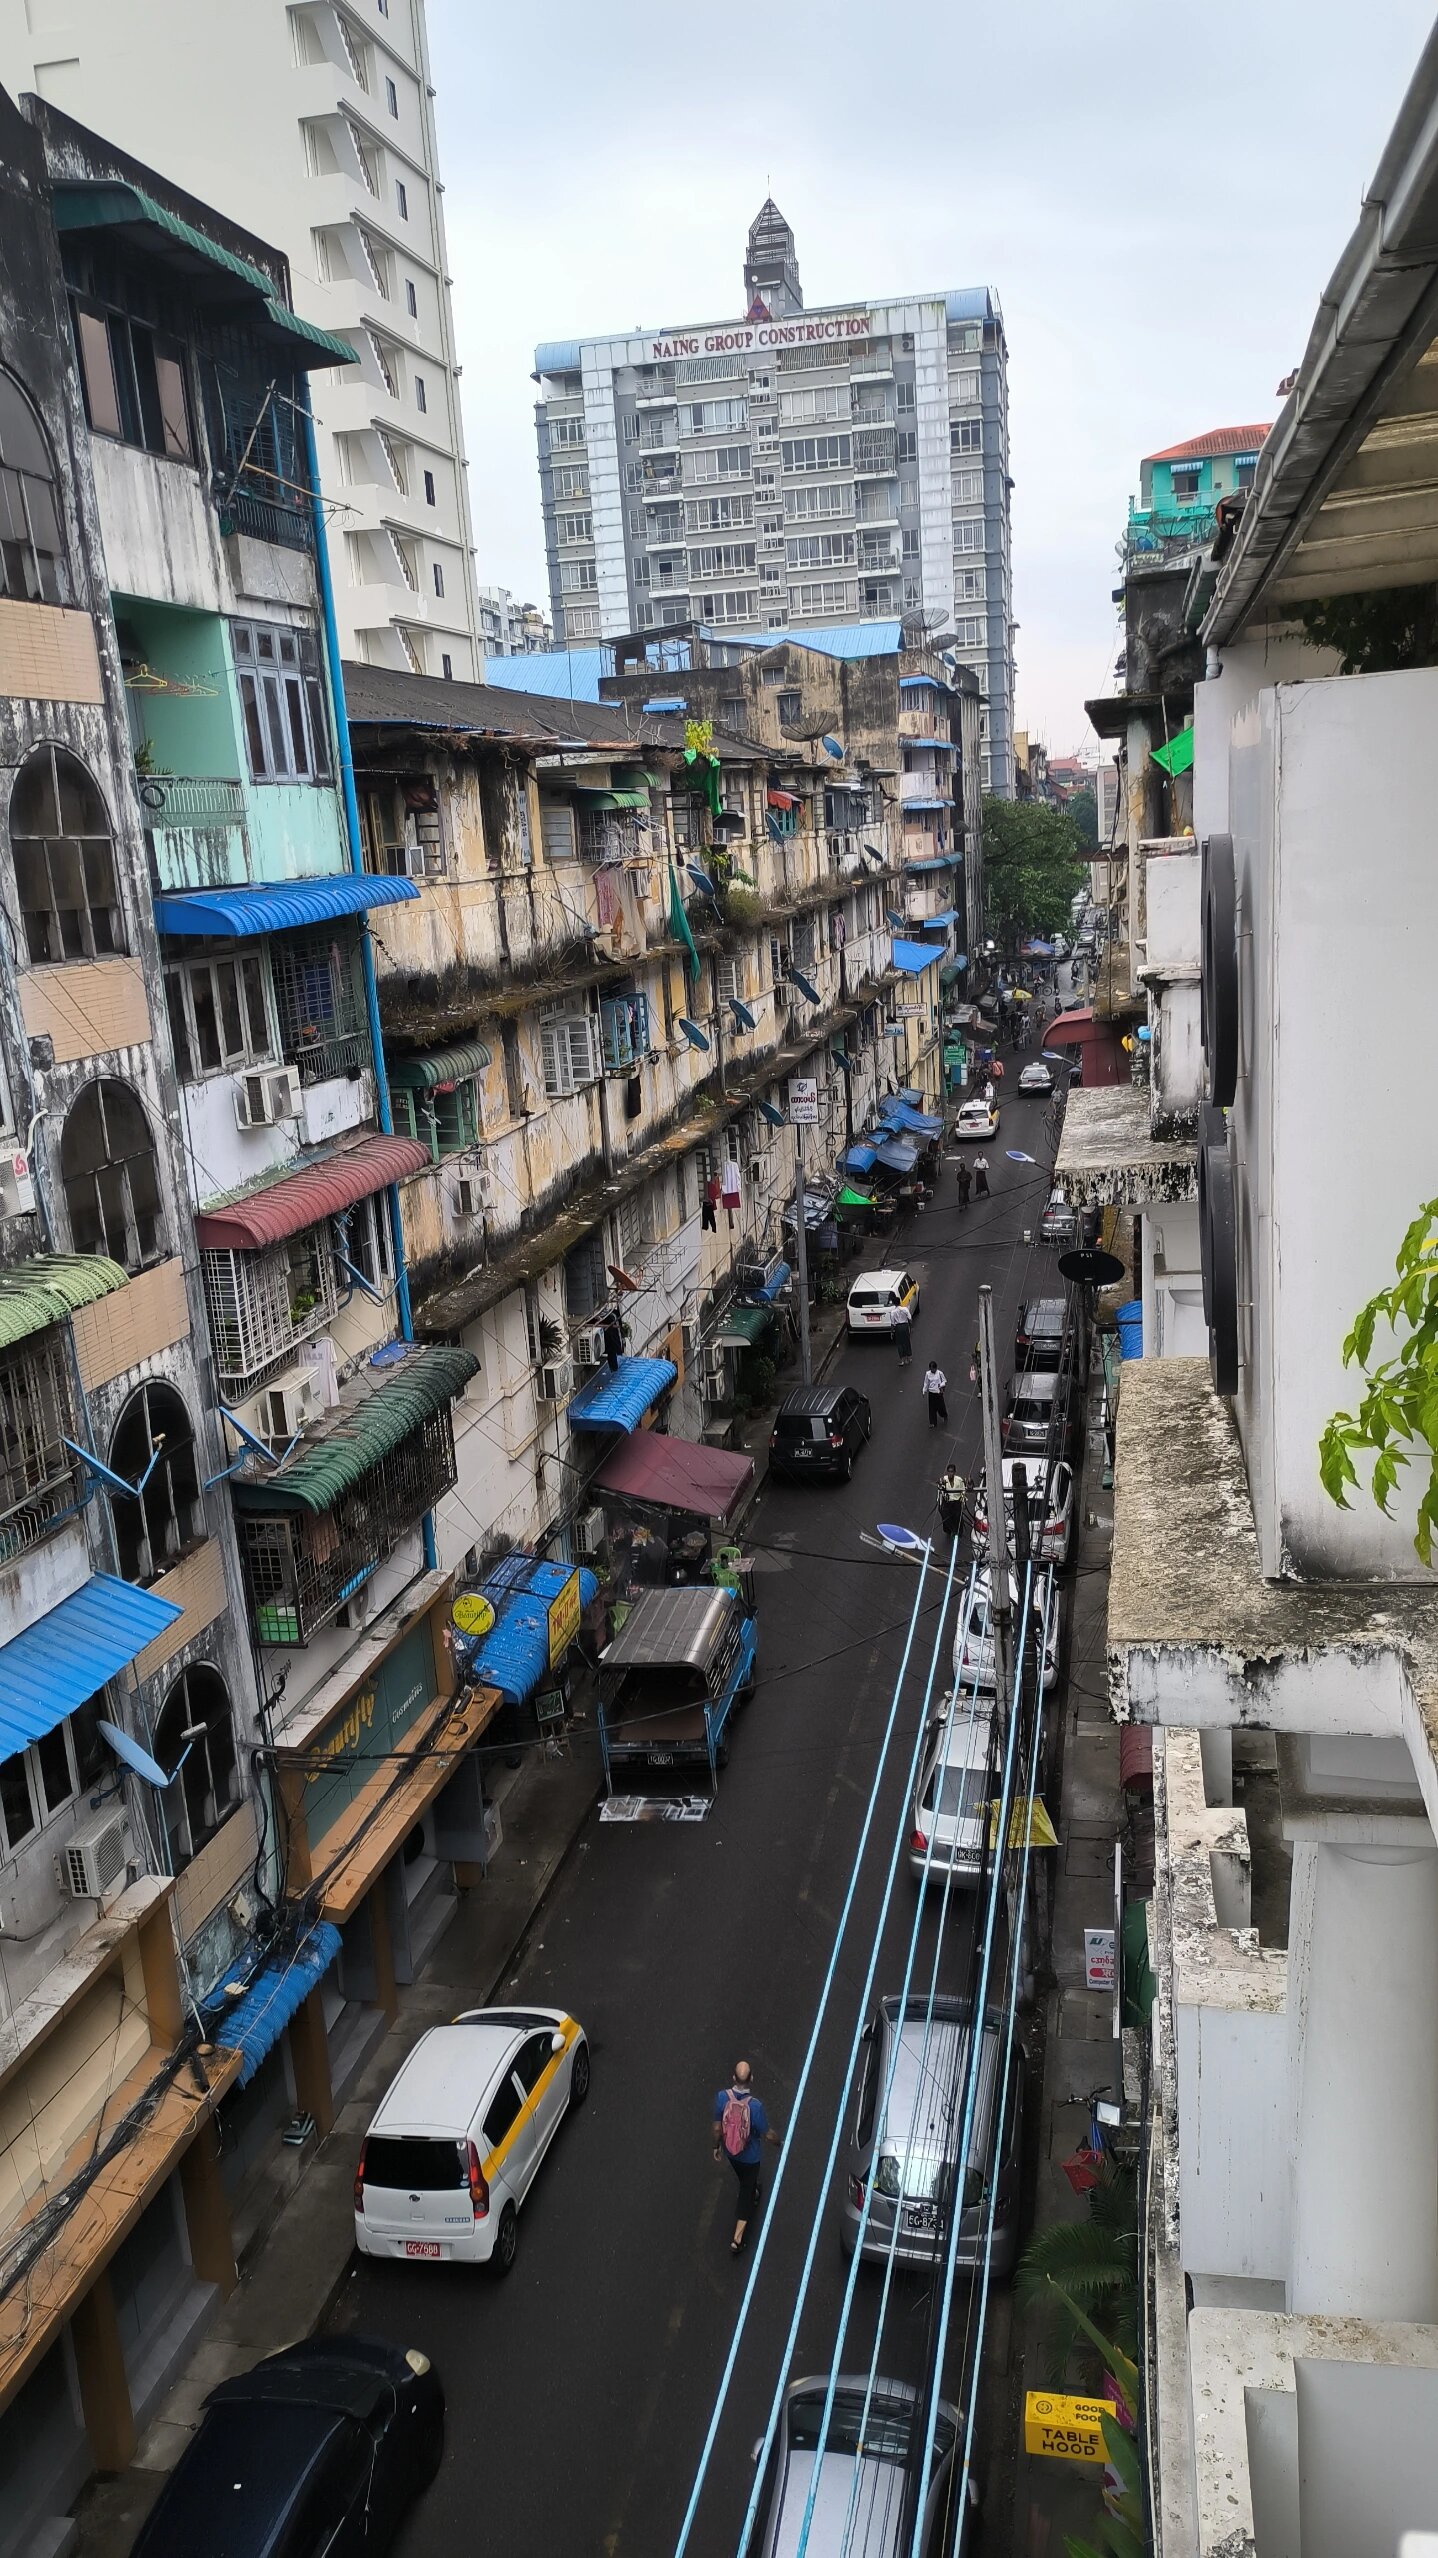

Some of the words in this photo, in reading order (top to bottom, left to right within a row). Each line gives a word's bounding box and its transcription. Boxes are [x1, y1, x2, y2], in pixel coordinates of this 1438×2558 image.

[652, 338, 700, 359] NAING
[704, 331, 753, 351] GROUP
[758, 317, 870, 346] CONSTRUCTION
[1042, 2428, 1100, 2445] TABLE
[1042, 2440, 1096, 2456] HOOD
